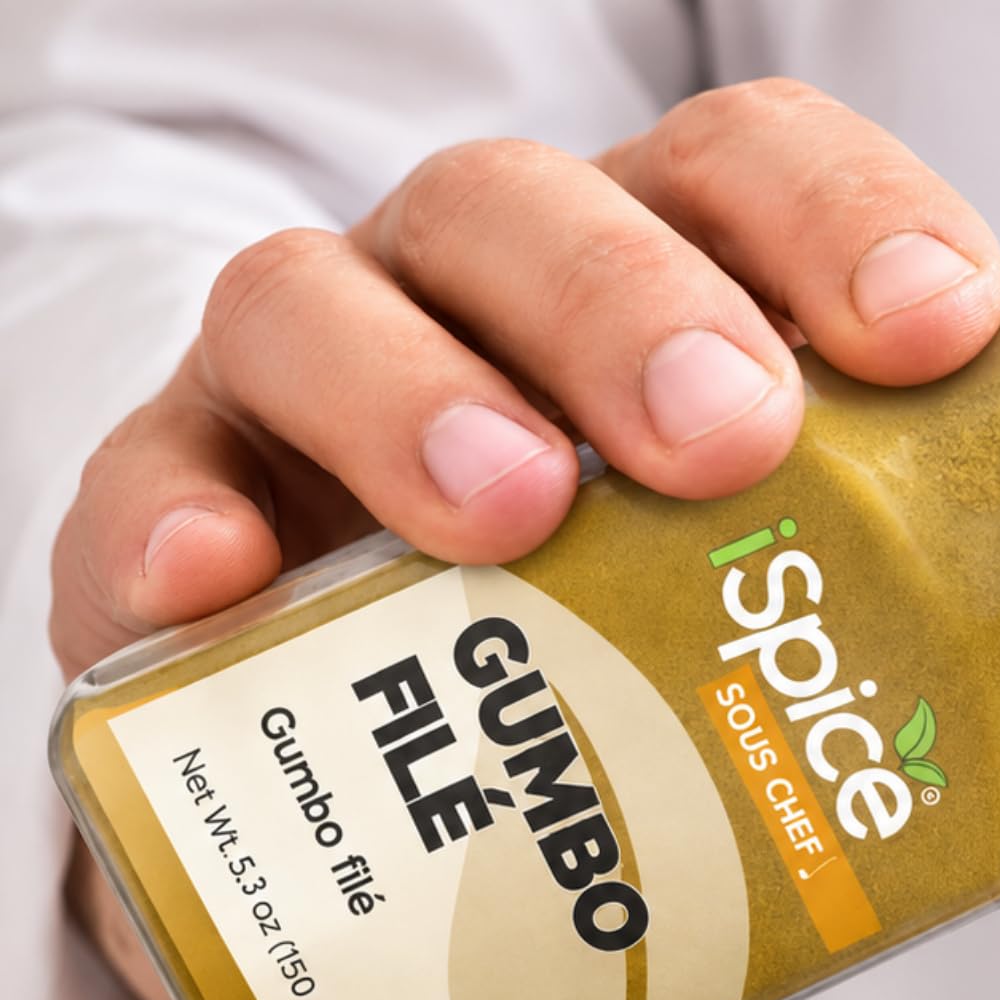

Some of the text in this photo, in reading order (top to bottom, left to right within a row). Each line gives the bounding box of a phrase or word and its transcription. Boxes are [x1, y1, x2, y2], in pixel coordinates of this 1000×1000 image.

[351, 654, 516, 853] FILÉ
[453, 617, 650, 952] GUMBO
[708, 517, 912, 841] iSpice
[716, 683, 824, 855] SOUS CHEF
[172, 747, 215, 806] Net
[252, 901, 282, 937] oz
[268, 940, 316, 997] (150
[260, 707, 386, 916] Gumbo filé
